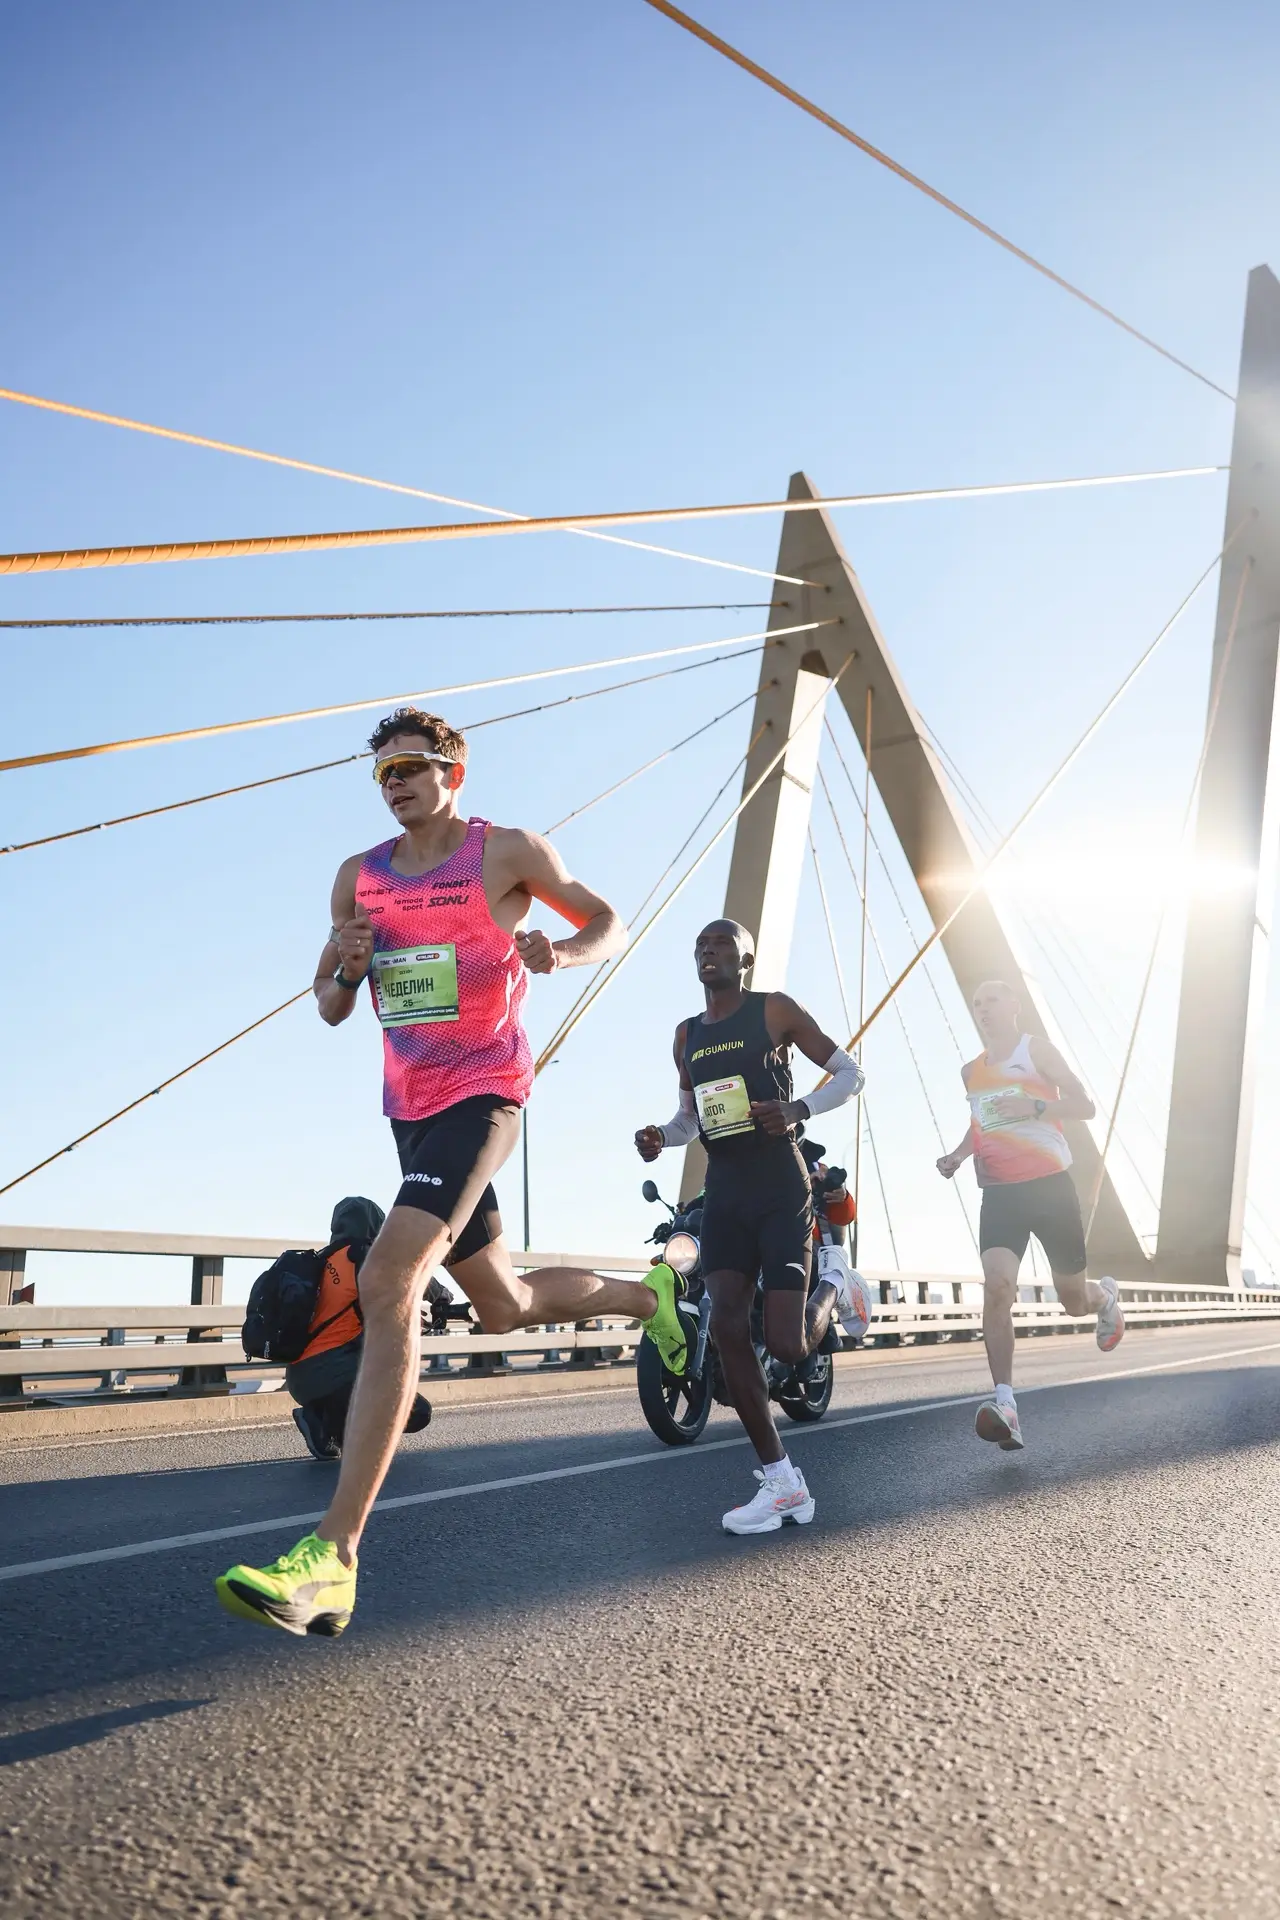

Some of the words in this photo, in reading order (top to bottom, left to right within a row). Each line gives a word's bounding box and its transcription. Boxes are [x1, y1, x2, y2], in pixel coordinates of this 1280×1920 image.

[432, 880, 472, 890] FONBET
[402, 999, 414, 1008] 25
[704, 1040, 744, 1056] GUANJUN
